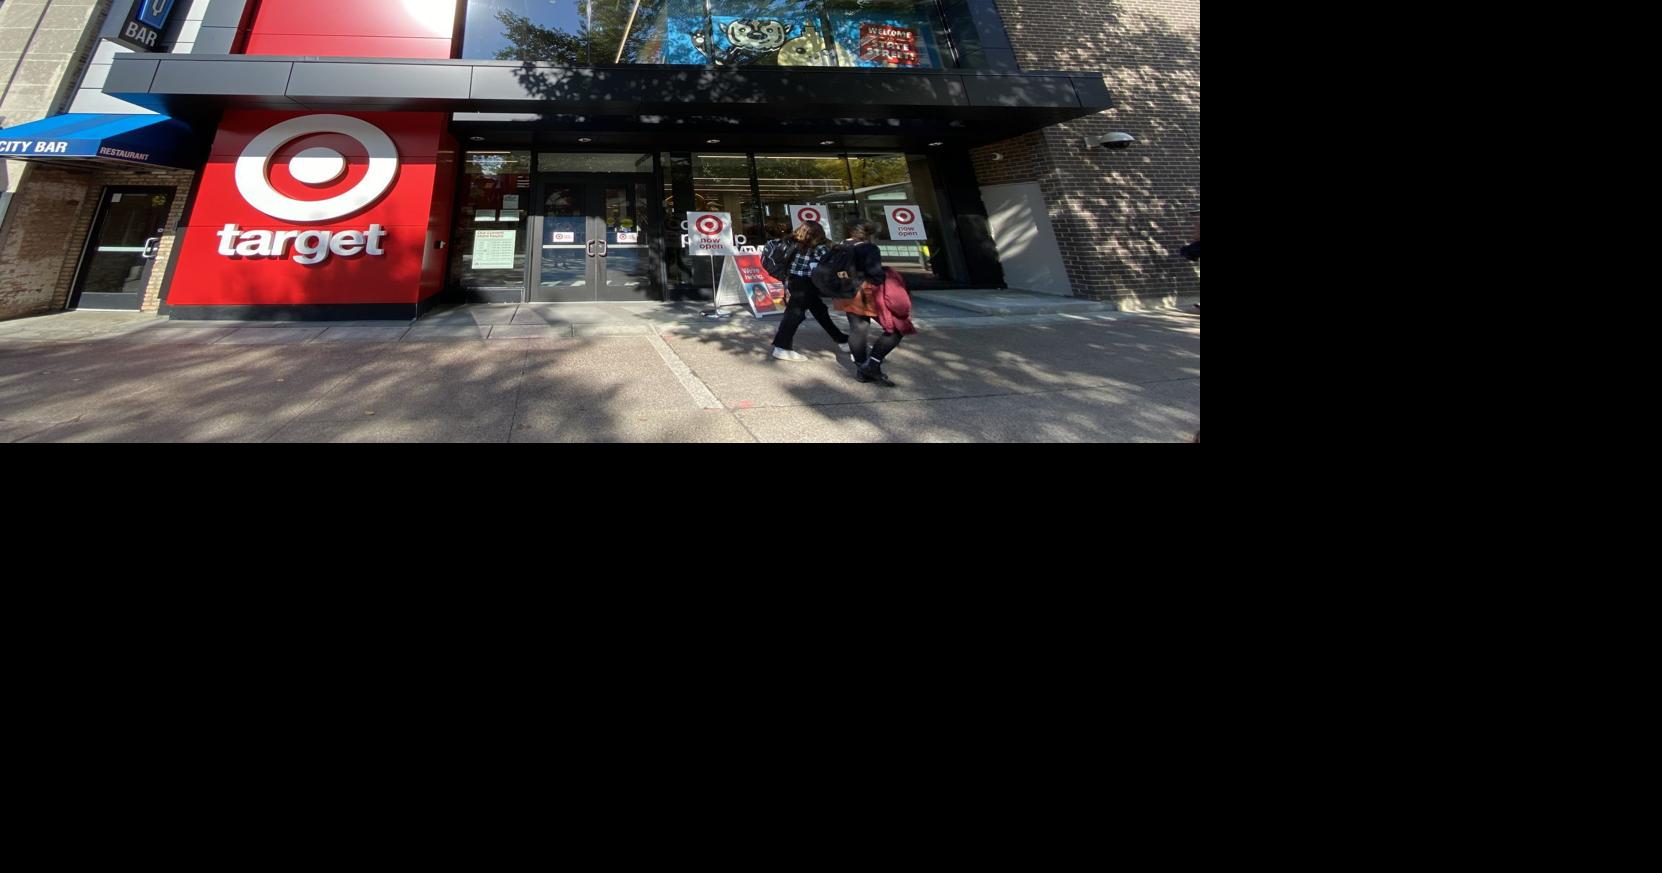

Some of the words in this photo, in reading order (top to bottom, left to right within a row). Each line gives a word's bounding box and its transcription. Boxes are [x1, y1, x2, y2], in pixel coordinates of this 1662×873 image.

[125, 21, 157, 47] BAR
[868, 27, 912, 38] WELCOME
[871, 40, 910, 51] STATE
[0, 141, 32, 153] CITY
[34, 141, 68, 153] BAR
[99, 147, 149, 161] RESTAURANT
[217, 223, 386, 264] target
